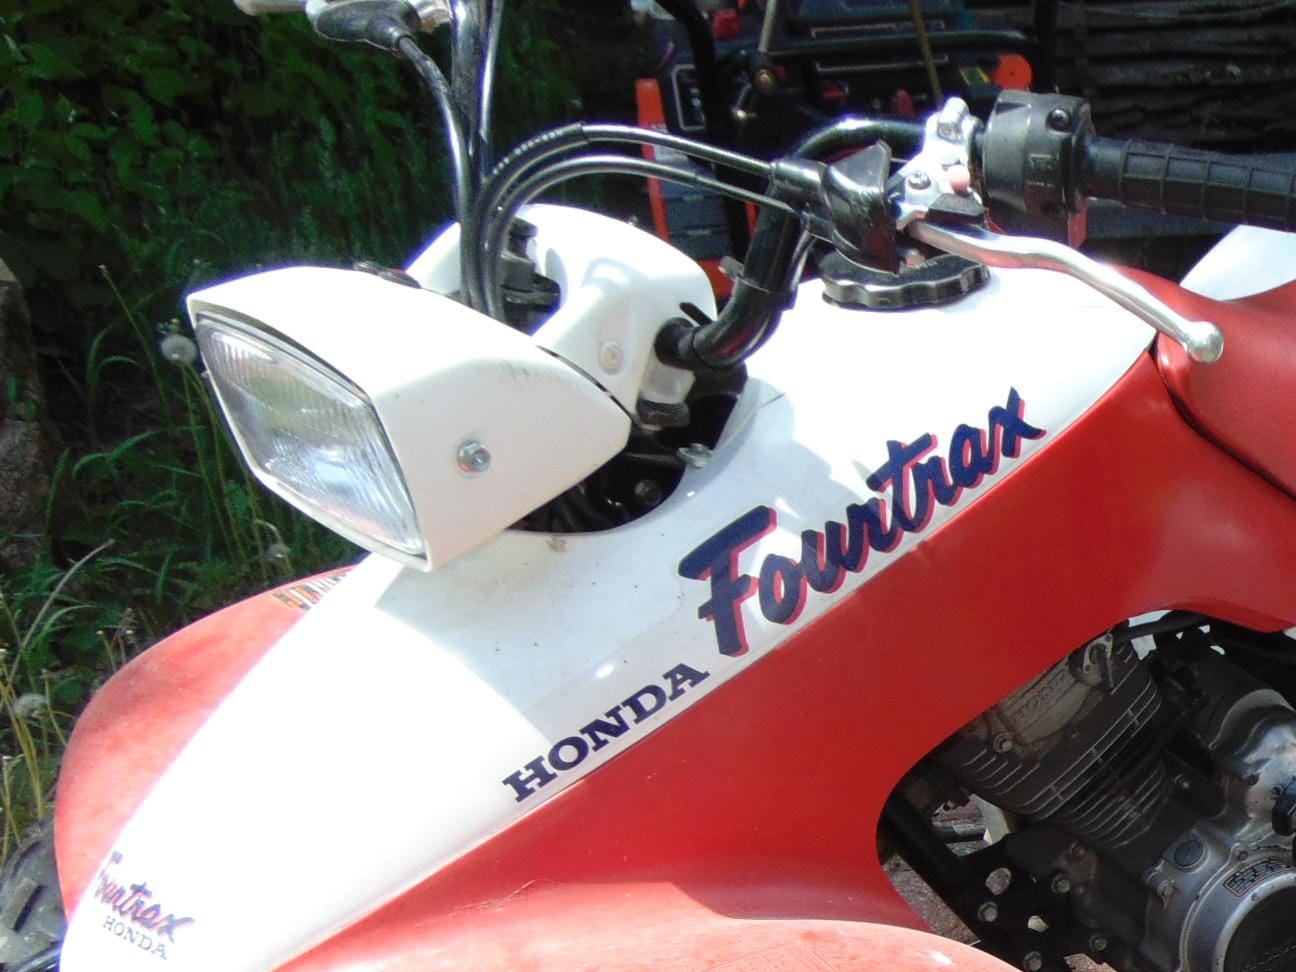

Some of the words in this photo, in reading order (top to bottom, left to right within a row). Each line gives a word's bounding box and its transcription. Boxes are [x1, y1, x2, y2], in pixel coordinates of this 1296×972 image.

[678, 386, 1047, 657] Fourtrax
[502, 662, 711, 803] HONDA
[102, 915, 168, 960] HONDA
